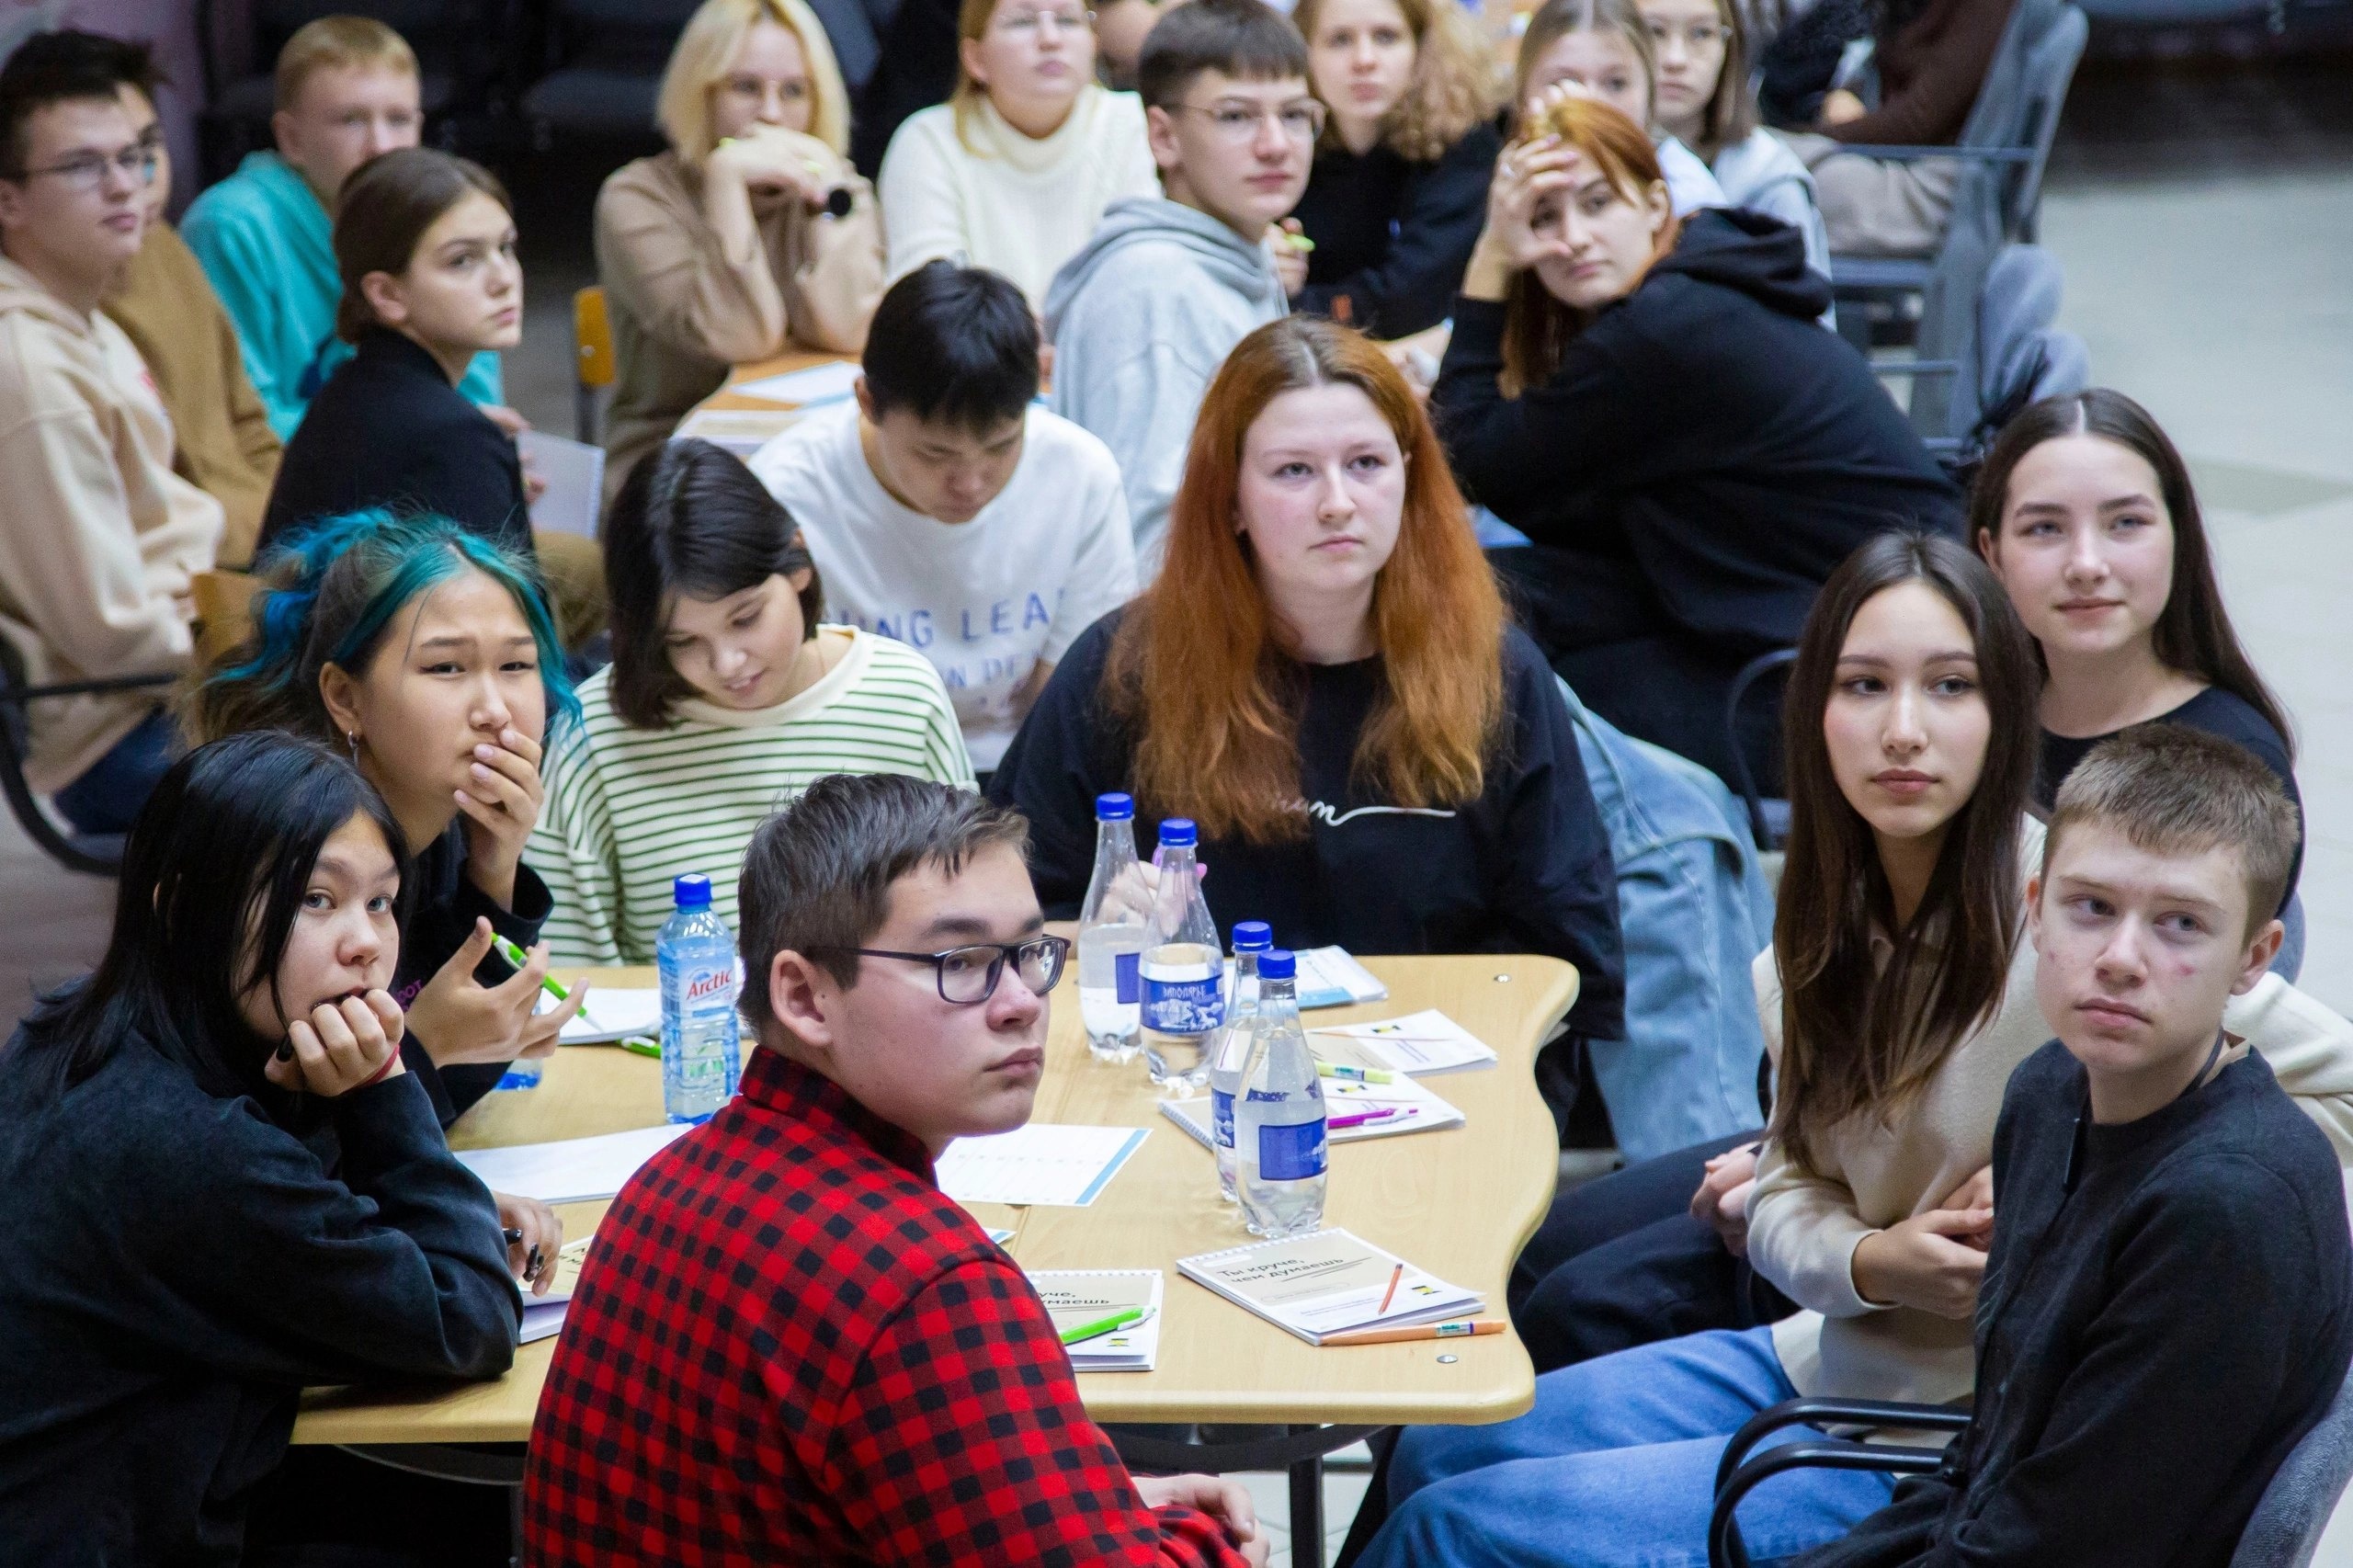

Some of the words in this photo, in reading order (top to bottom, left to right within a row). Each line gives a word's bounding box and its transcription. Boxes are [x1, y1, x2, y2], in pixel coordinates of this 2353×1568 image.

[686, 970, 733, 1000] Arctic
[1216, 1268, 1243, 1277] Ты
[1246, 1259, 1304, 1272] круче,
[1231, 1273, 1265, 1283] чем
[1269, 1257, 1344, 1278] думаешь
